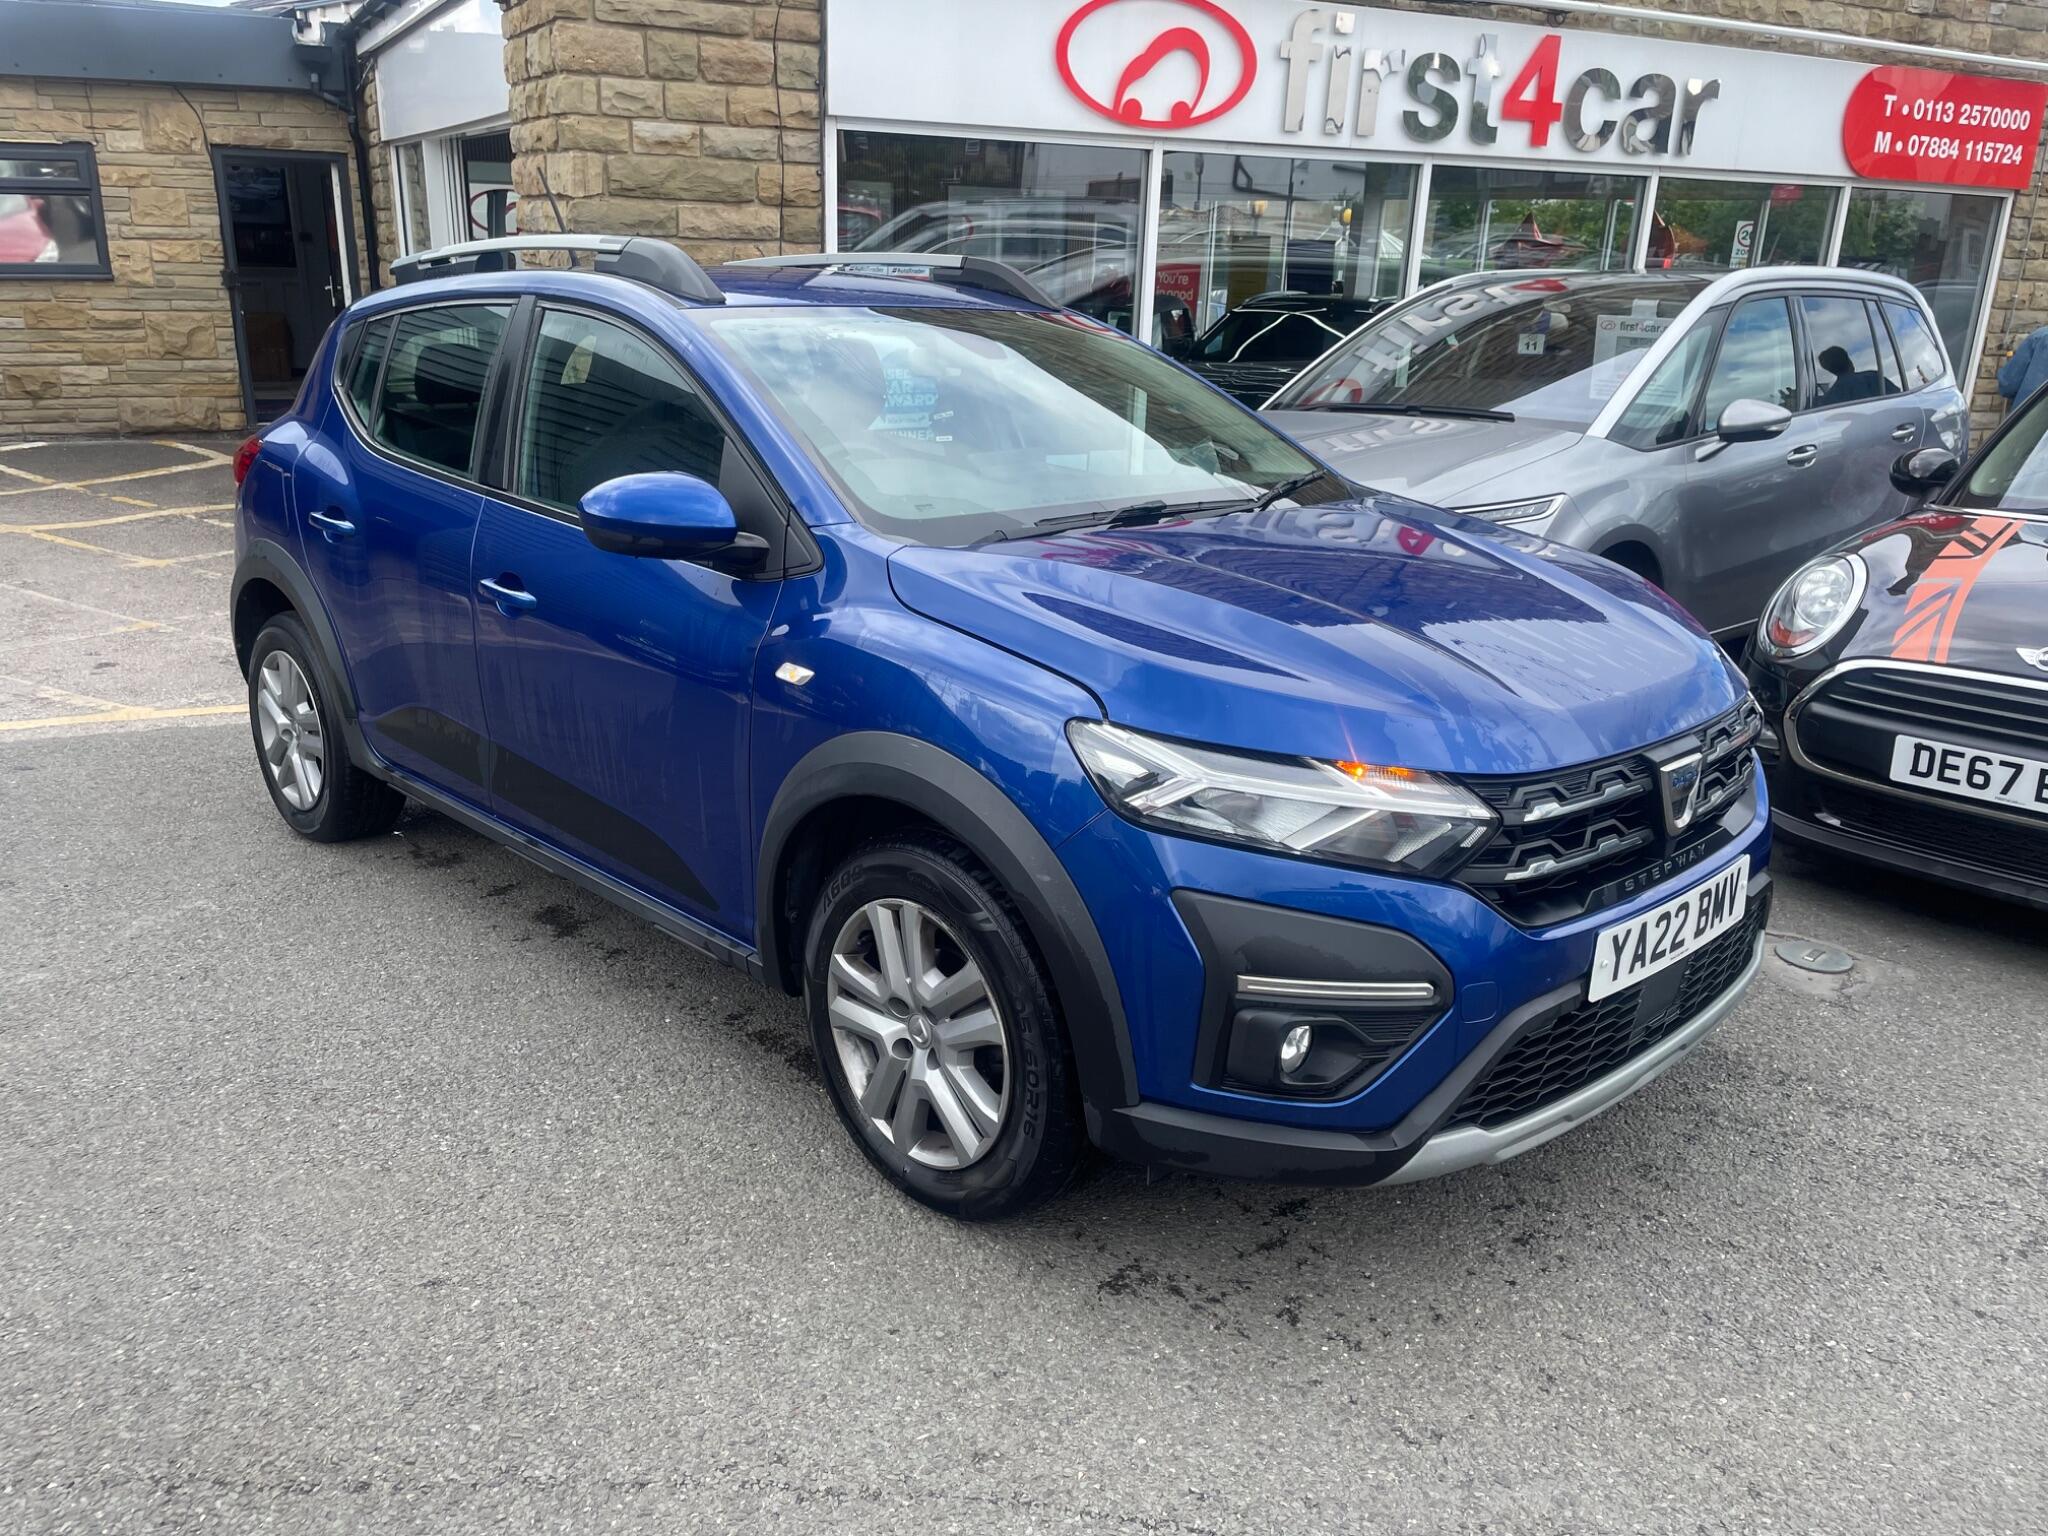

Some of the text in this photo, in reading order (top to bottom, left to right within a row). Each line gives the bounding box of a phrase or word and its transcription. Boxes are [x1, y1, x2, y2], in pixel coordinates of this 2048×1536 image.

[1279, 8, 1721, 157] first4car
[1884, 94, 2031, 131] T 0113 2570000
[1873, 131, 2023, 165] M 07884 115724
[1158, 271, 1189, 286] You're
[1524, 341, 1538, 351] 11
[1909, 742, 2024, 796] DE67
[1624, 843, 1706, 892] STEPWAY
[1611, 866, 1742, 982] YA22 BMV
